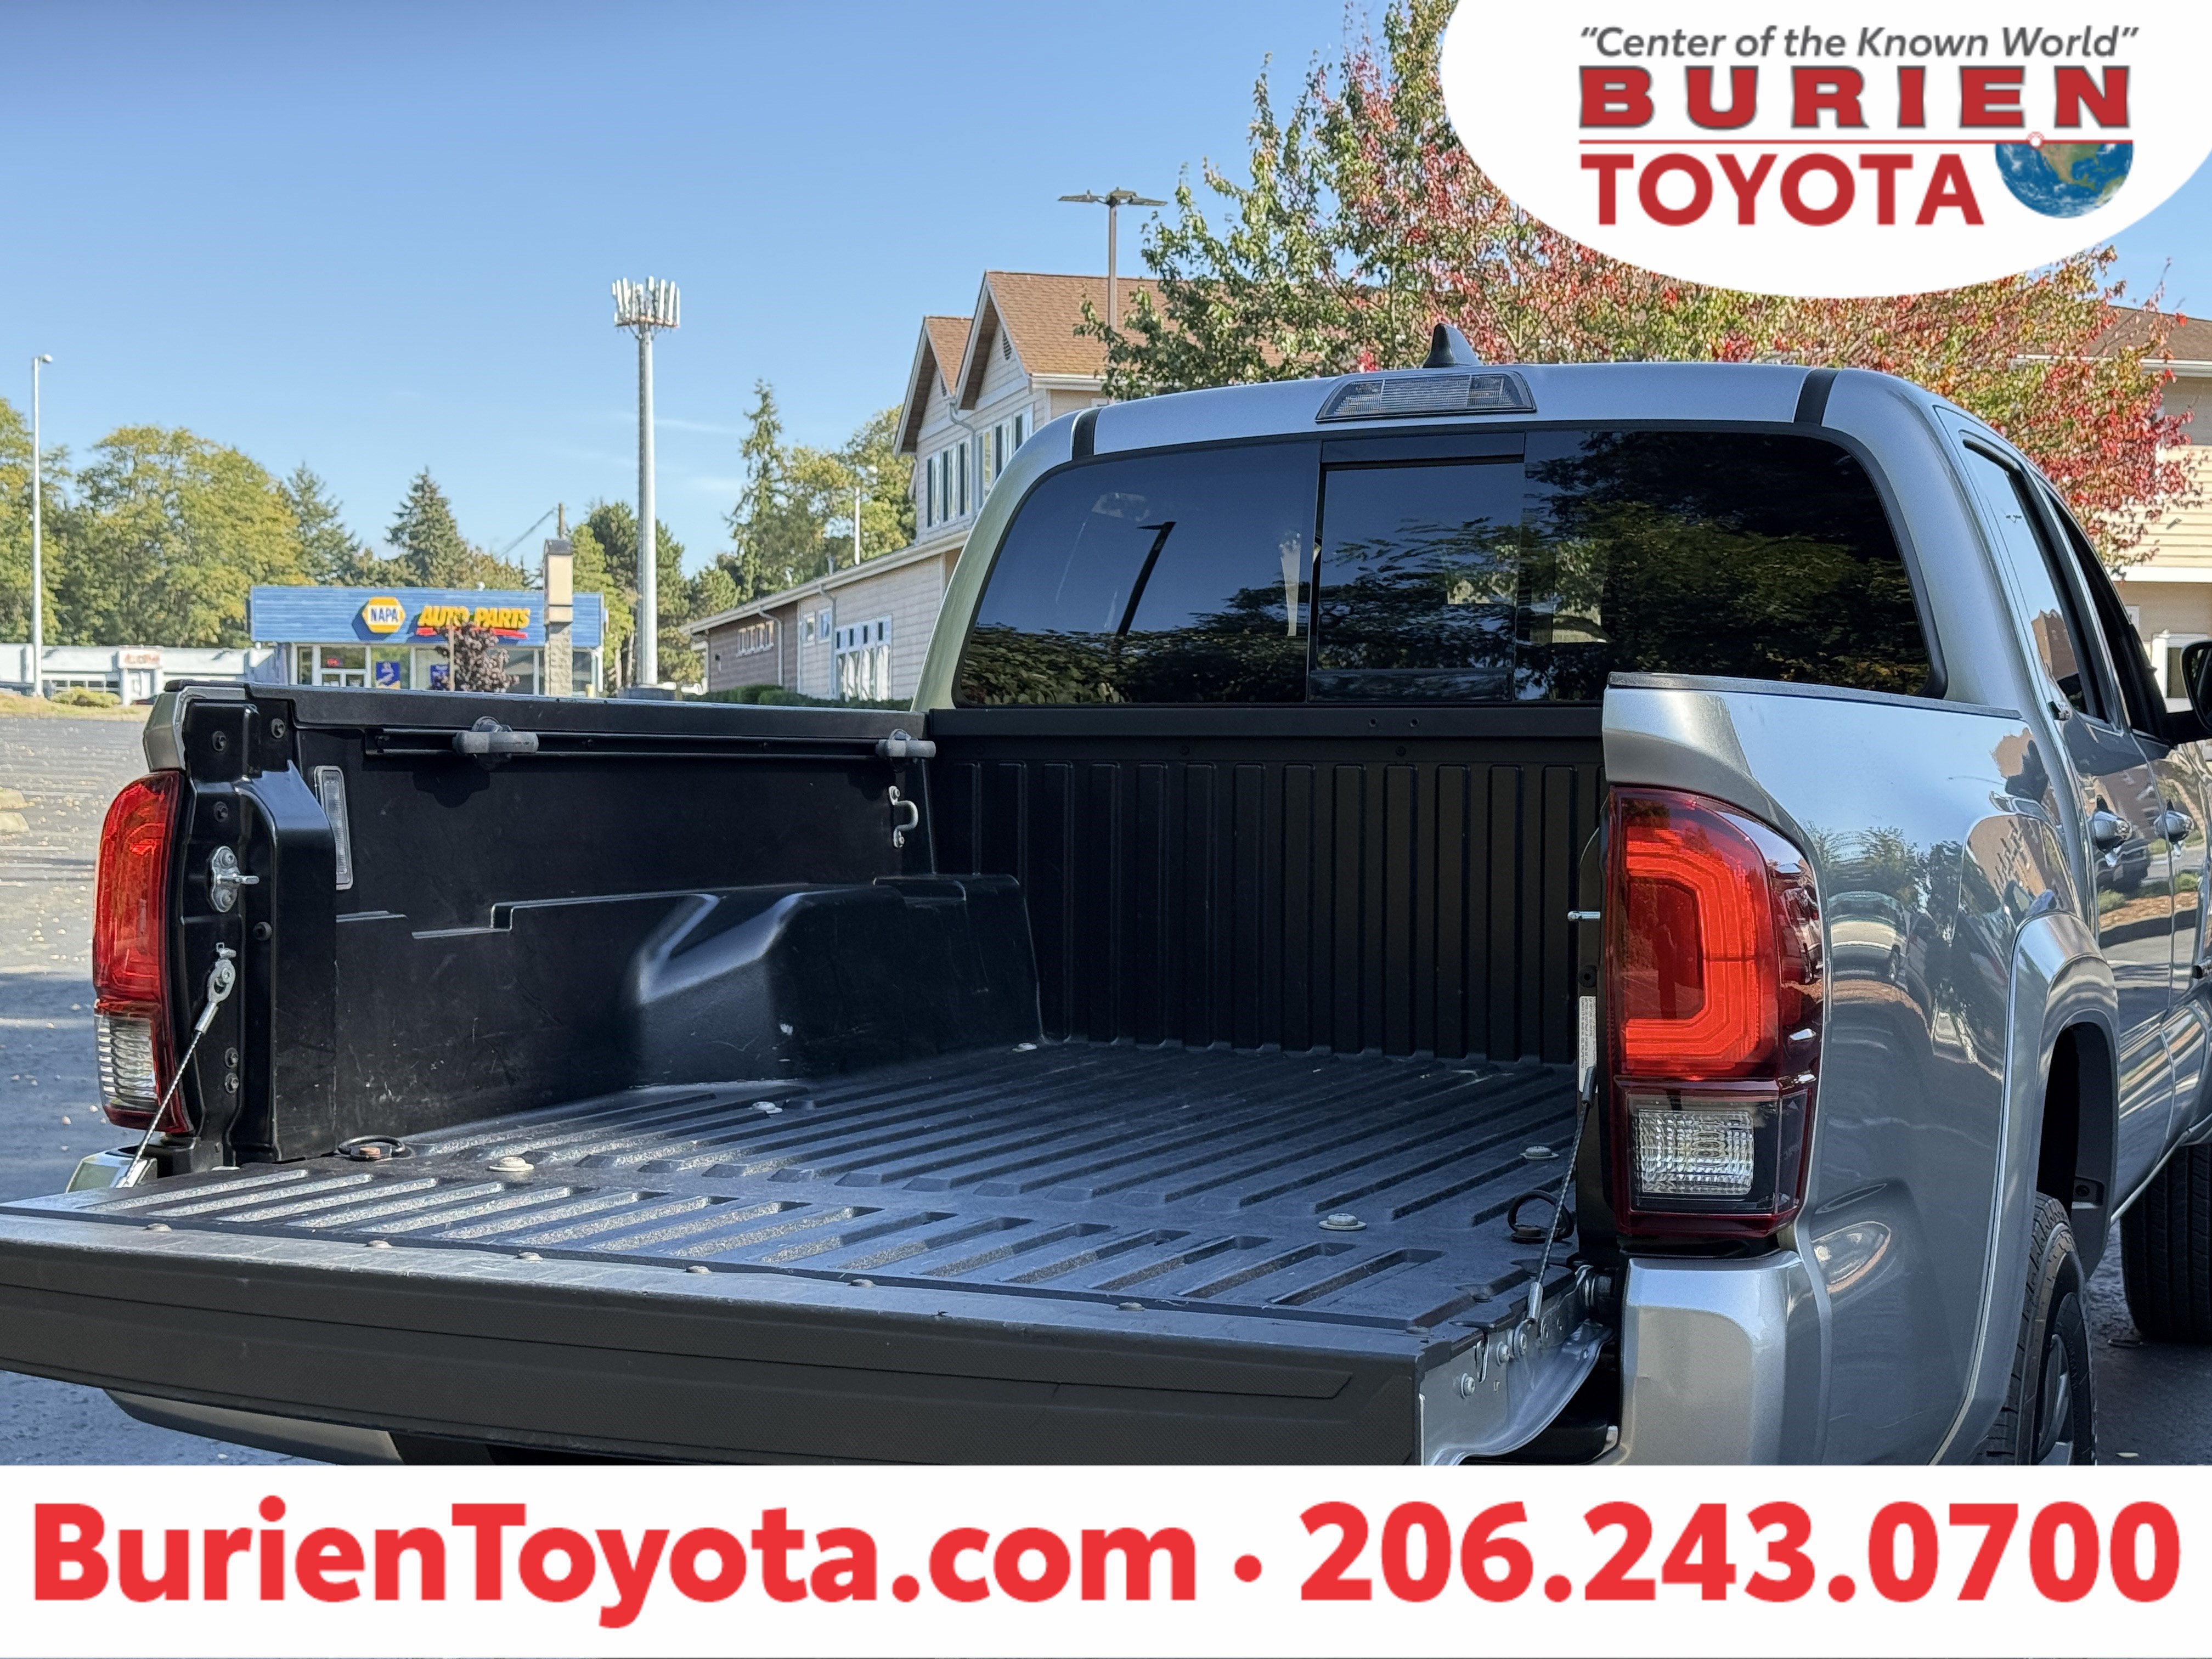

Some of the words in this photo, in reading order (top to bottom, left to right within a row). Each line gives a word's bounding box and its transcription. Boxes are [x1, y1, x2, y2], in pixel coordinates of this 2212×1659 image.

[371, 608, 398, 622] NAPA
[417, 606, 470, 627] AUTO
[473, 607, 531, 629] PARTS
